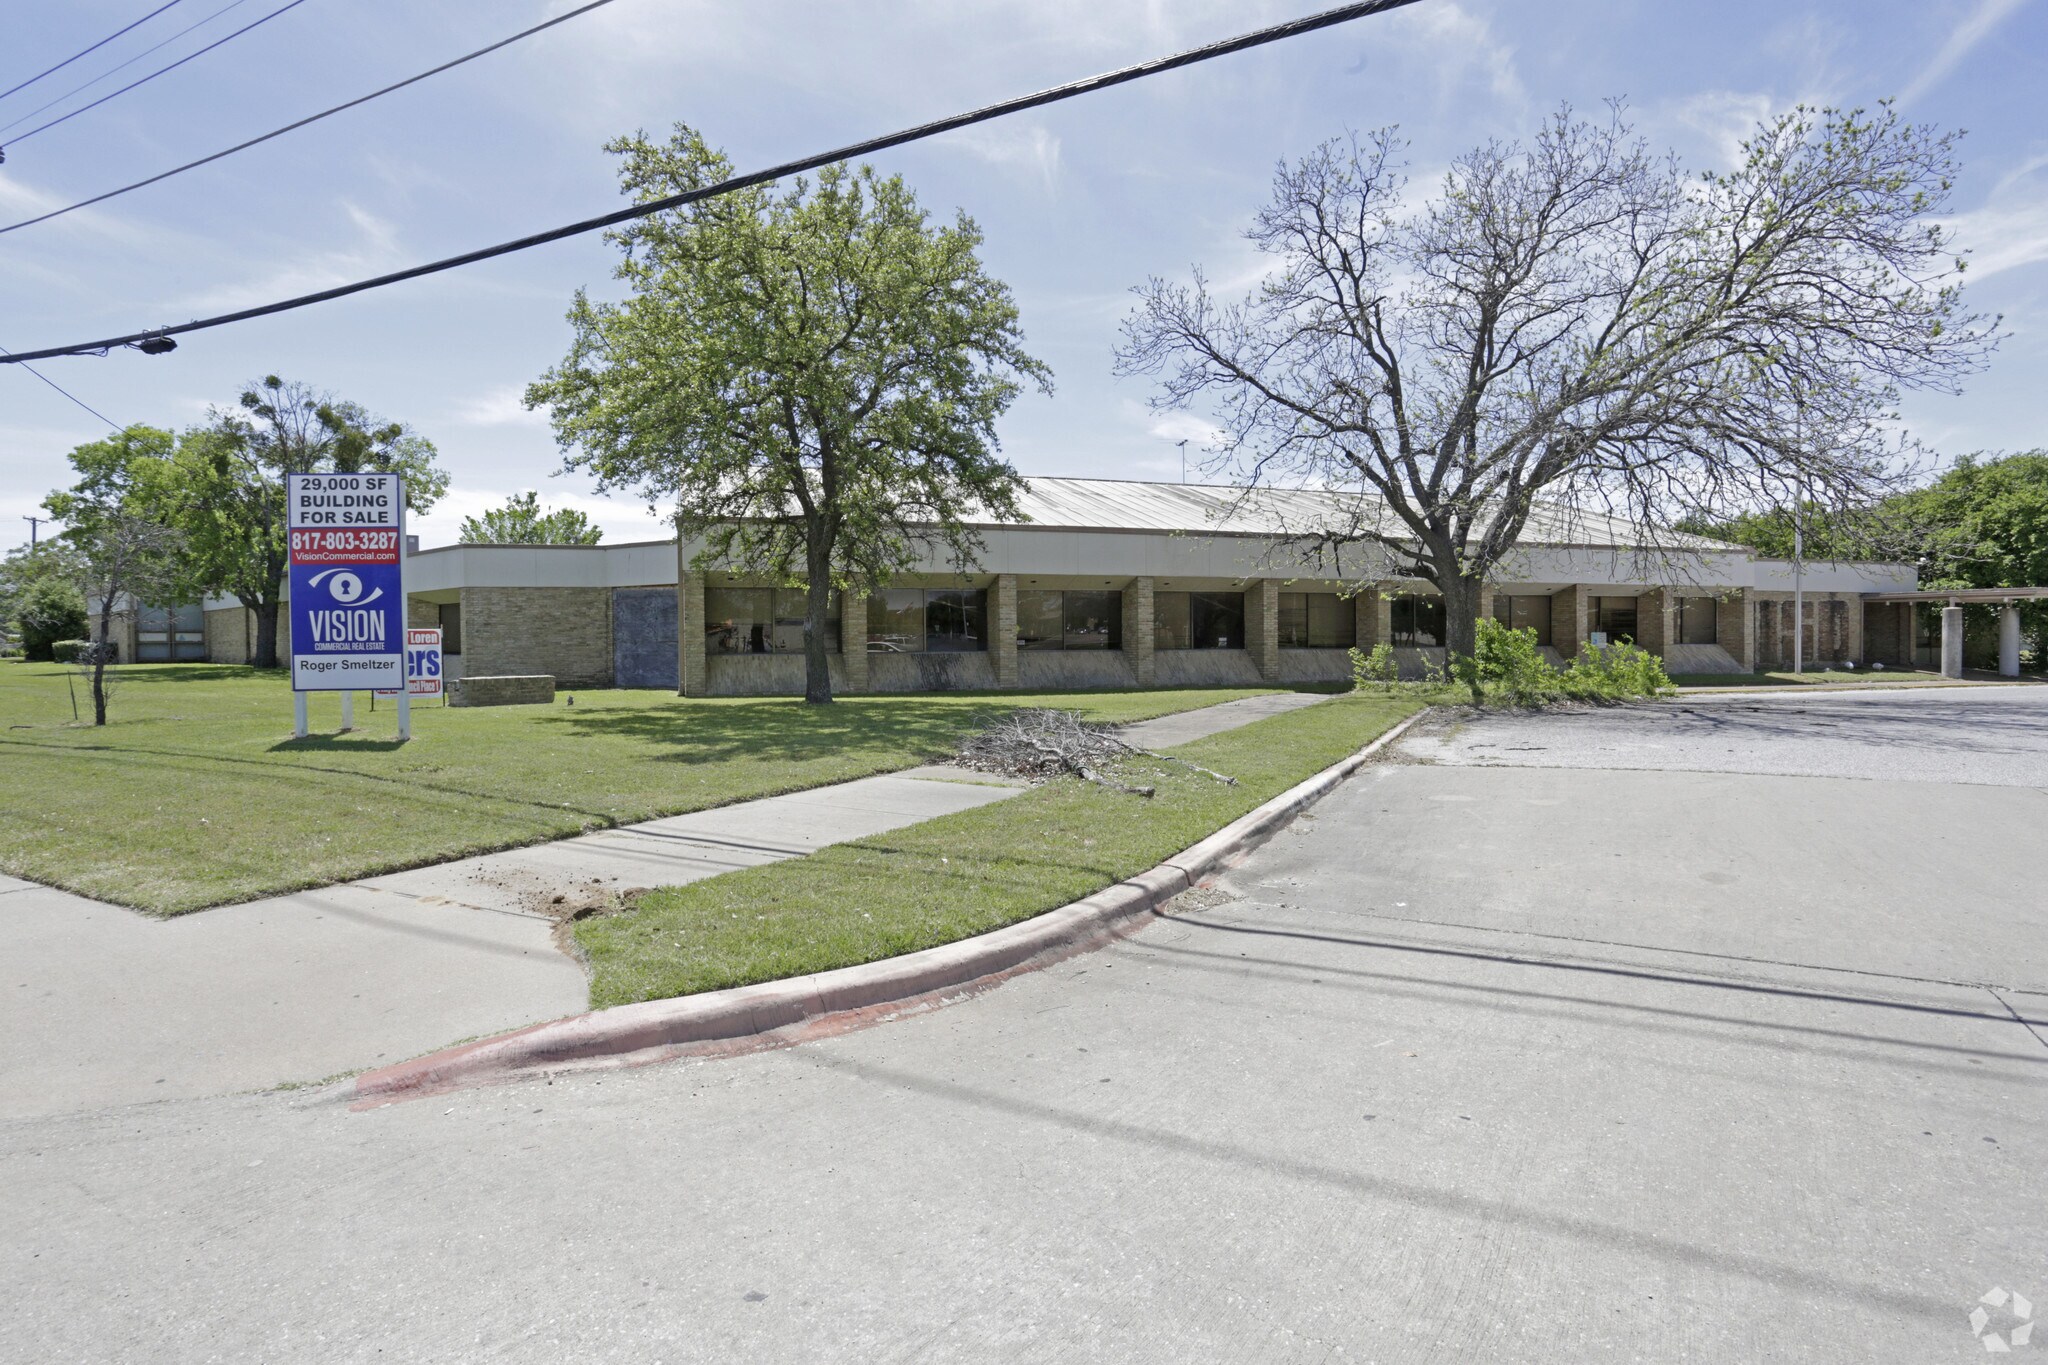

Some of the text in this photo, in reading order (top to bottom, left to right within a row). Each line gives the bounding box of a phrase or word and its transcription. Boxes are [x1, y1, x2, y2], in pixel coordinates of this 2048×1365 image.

[301, 478, 387, 493] 29,000 SF
[301, 495, 388, 507] BUILDING
[301, 511, 389, 524] FOR SALE
[292, 532, 398, 550] 817-803-3287
[296, 552, 396, 561] VisionCommercial.com
[309, 610, 385, 642] VISION
[410, 632, 437, 643] Loren
[315, 642, 385, 651] COMMERCIAL REAL ESTATE
[301, 660, 395, 673] Roger Smeltzer
